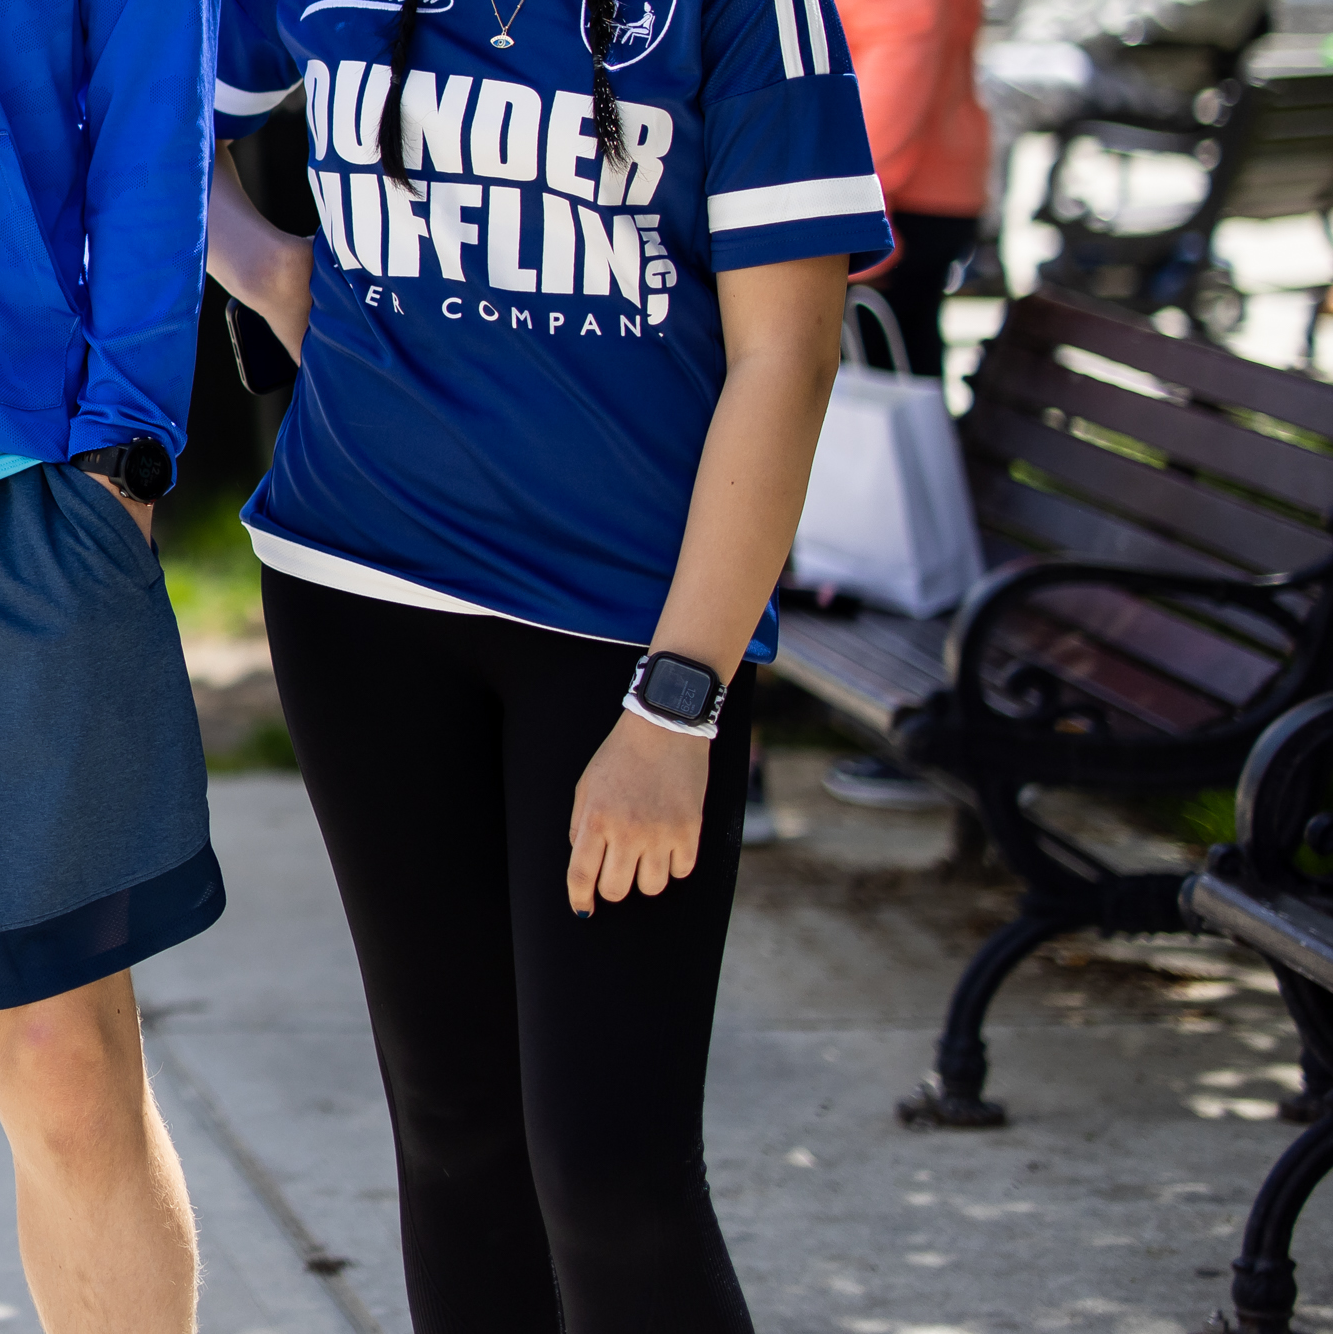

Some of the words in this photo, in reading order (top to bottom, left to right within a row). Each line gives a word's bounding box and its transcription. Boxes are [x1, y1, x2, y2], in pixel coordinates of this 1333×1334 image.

[307, 59, 674, 206] DUNDER
[441, 296, 663, 338] COMPAN
[680, 687, 696, 712] 12:29
